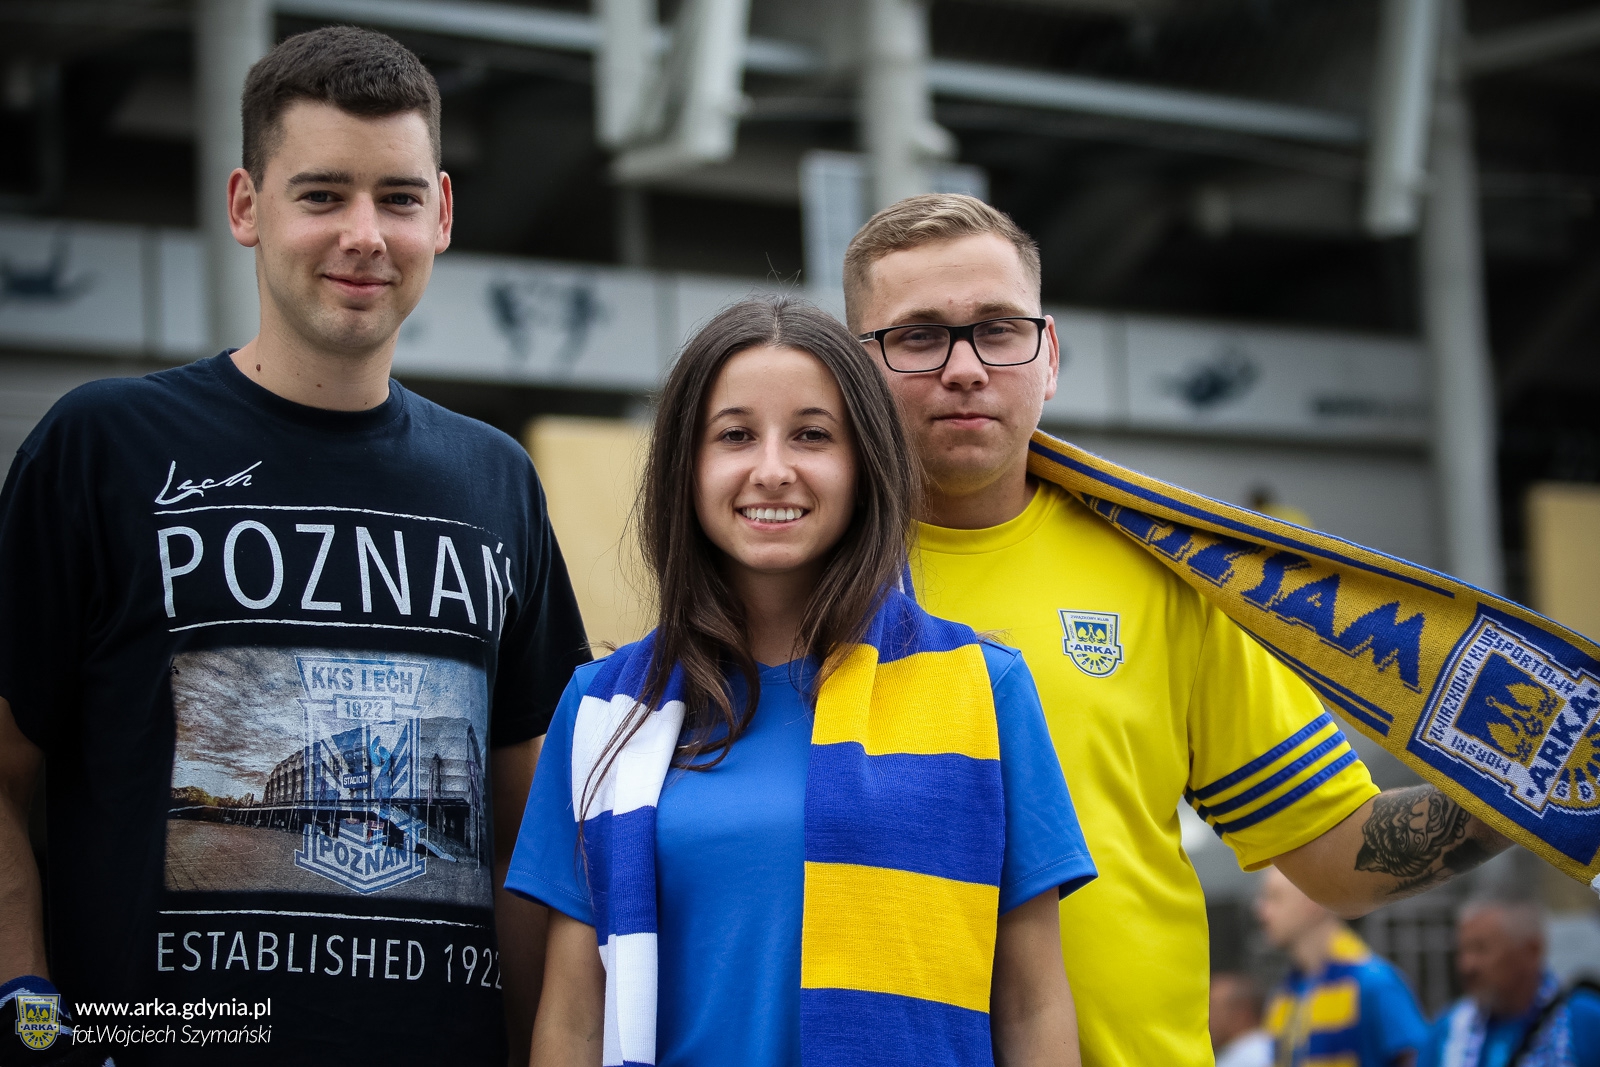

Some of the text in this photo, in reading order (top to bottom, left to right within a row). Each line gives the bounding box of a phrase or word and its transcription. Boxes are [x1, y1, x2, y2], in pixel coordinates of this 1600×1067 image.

[155, 460, 262, 504] Lech
[157, 519, 513, 641] POZNAŃ
[1074, 643, 1113, 656] ARKA
[311, 666, 413, 694] KKS LECH
[344, 701, 384, 719] 1922
[1528, 693, 1600, 795] ARKA
[343, 774, 368, 786] STADION
[157, 930, 426, 981] ESTABLISHED
